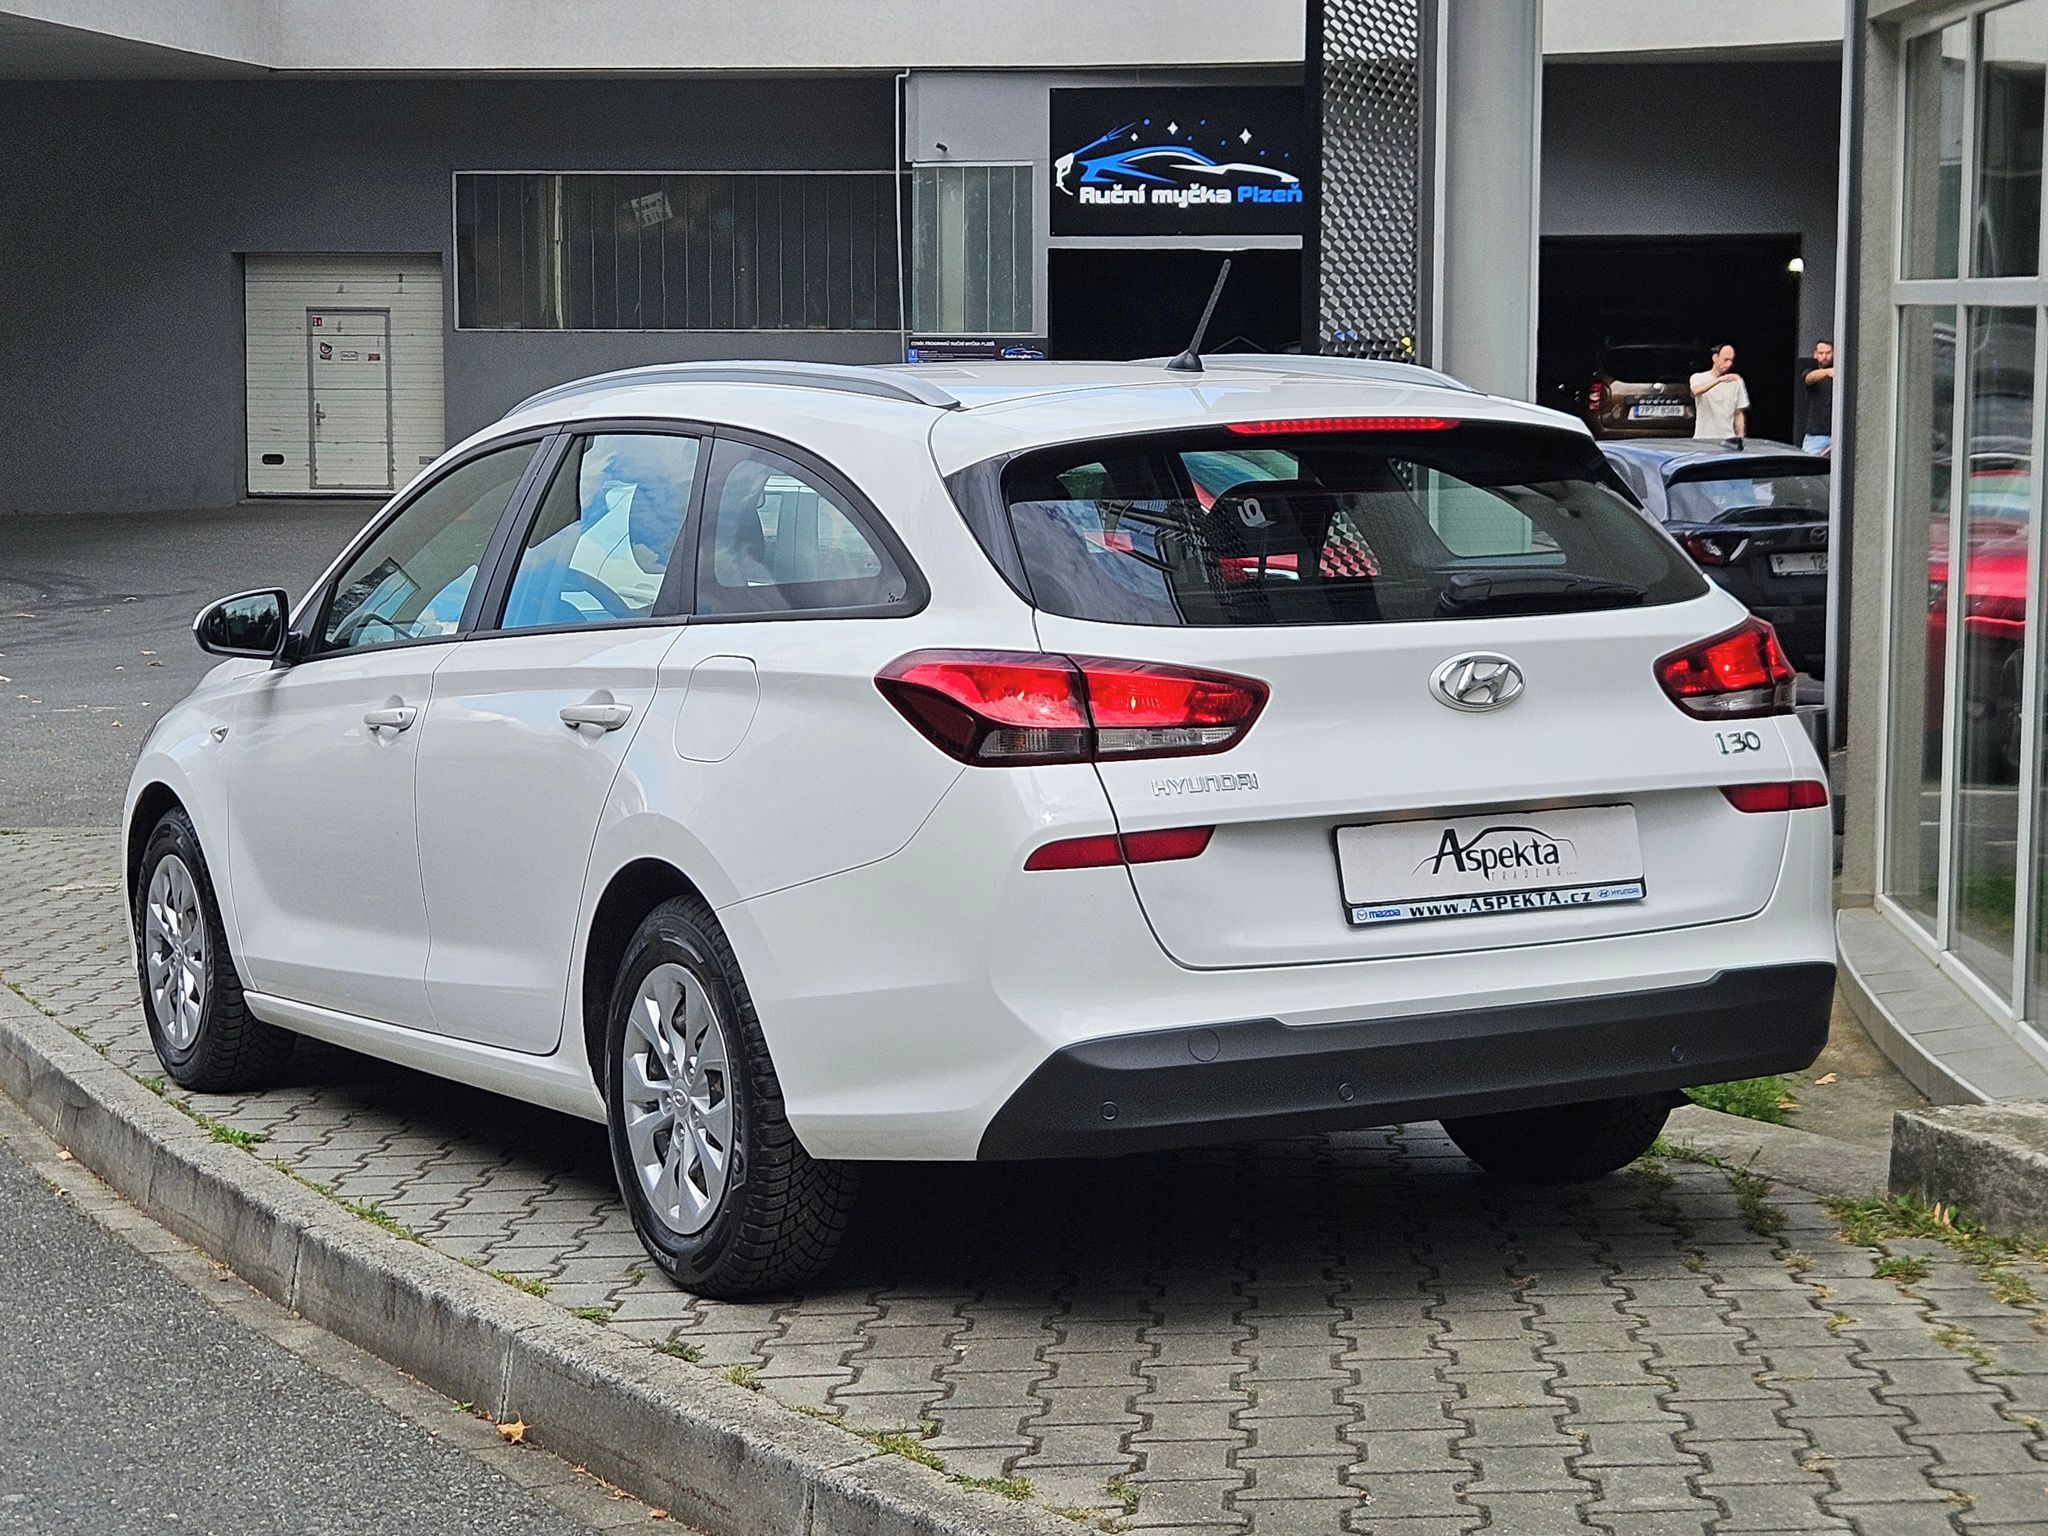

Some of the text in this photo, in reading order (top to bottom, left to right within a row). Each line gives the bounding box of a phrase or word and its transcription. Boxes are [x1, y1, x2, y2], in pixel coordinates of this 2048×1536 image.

[1079, 182, 1304, 208] Ruční myčka Plzeň
[1151, 772, 1259, 796] HYUNDAI
[1431, 828, 1560, 881] Aspekta
